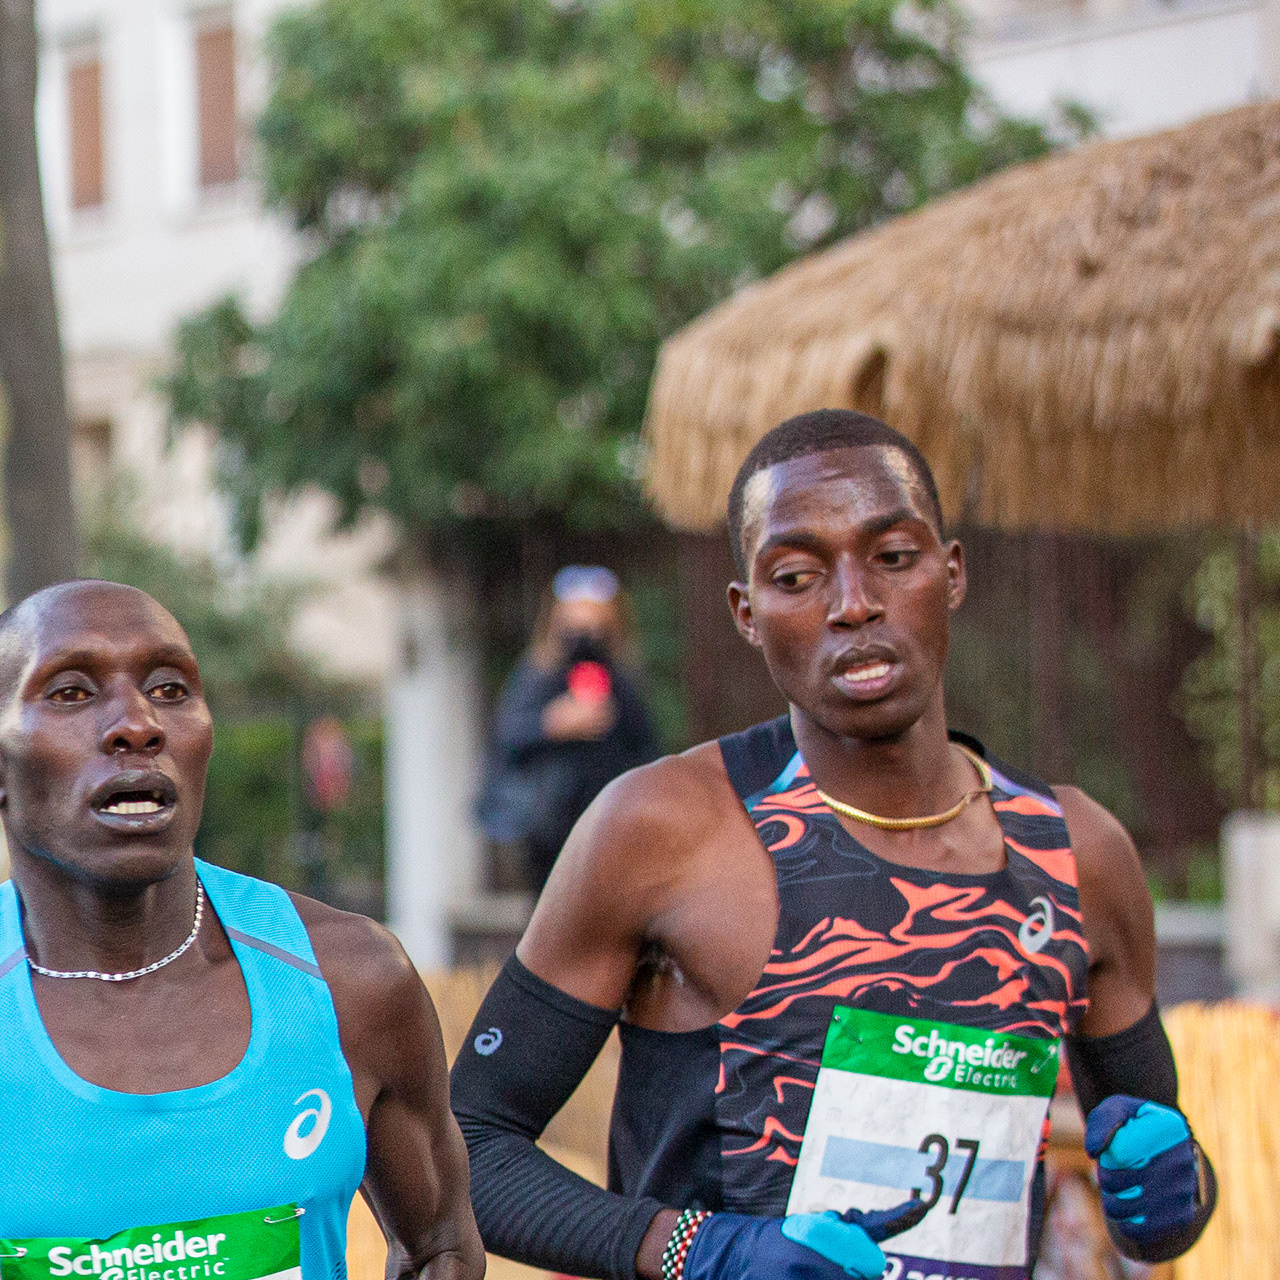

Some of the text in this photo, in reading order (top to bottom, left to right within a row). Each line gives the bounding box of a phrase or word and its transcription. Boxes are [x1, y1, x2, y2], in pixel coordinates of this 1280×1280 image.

[892, 1025, 1027, 1070] Schneider
[911, 1133, 980, 1215] 37
[49, 1230, 225, 1277] Schneider
